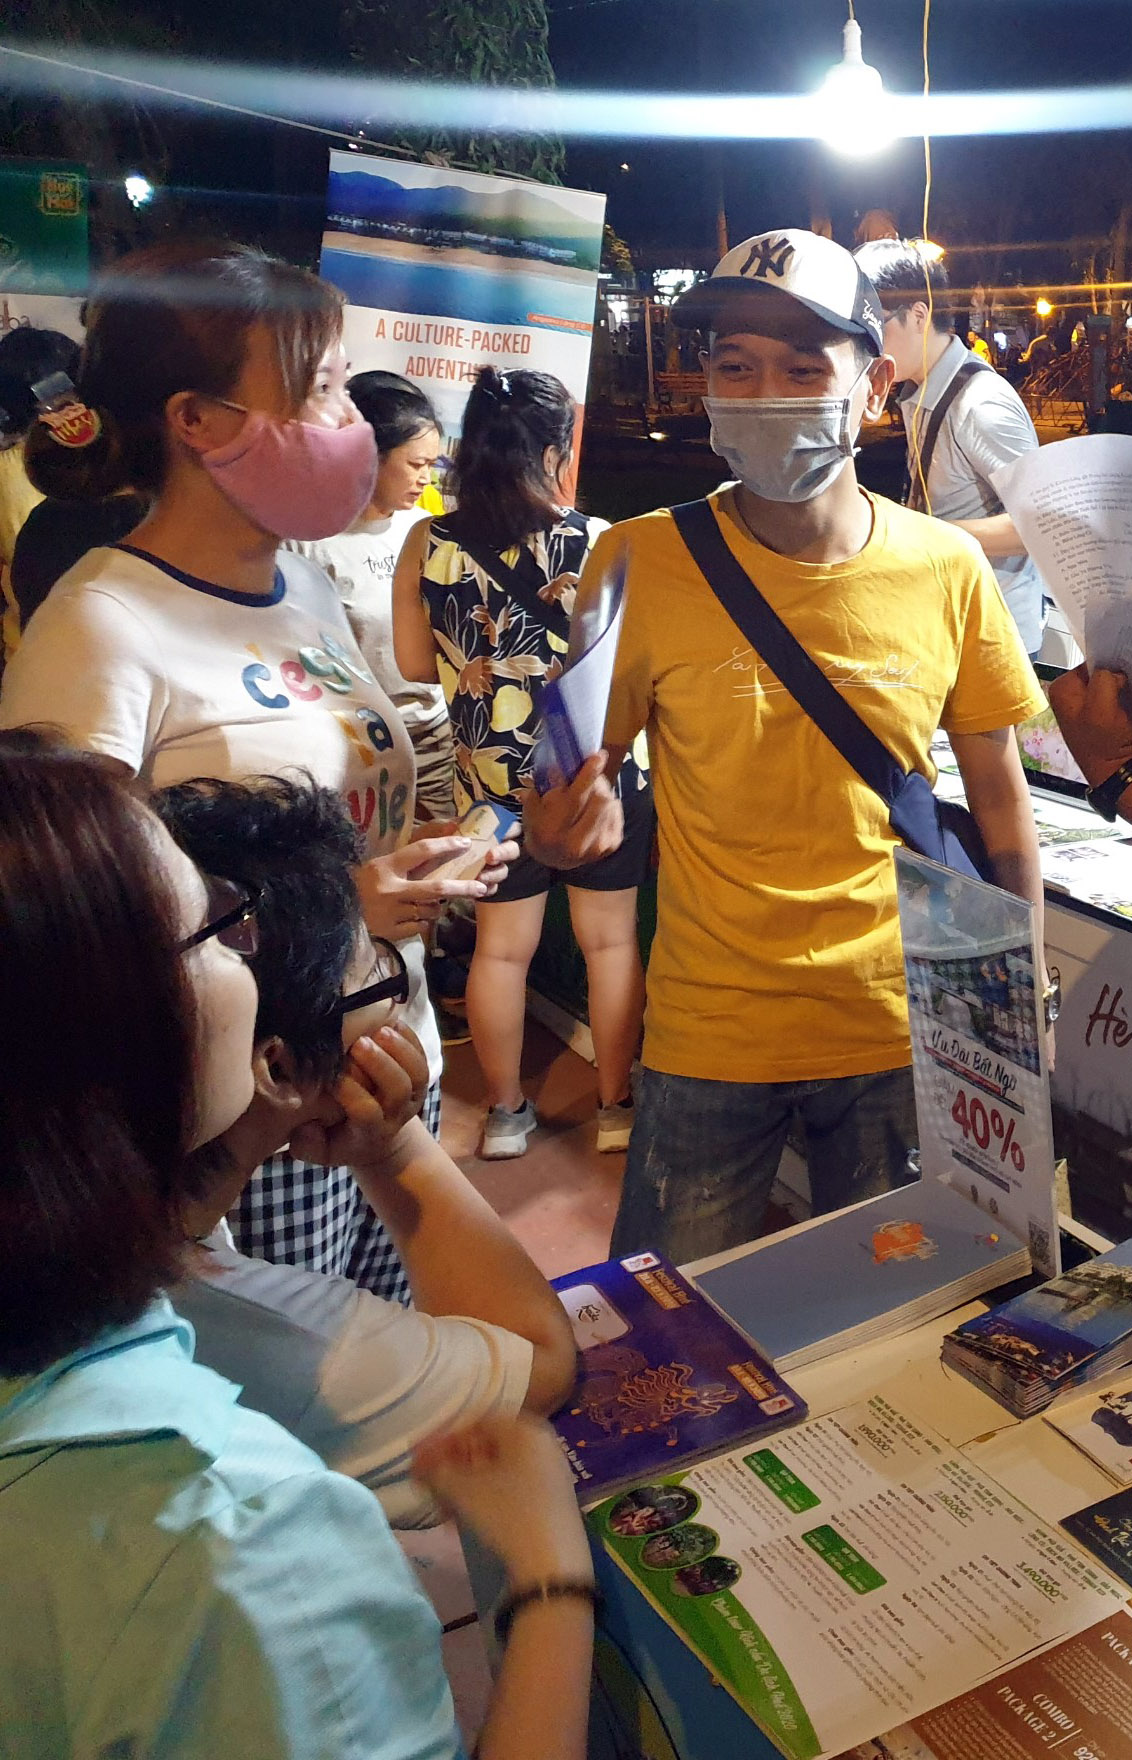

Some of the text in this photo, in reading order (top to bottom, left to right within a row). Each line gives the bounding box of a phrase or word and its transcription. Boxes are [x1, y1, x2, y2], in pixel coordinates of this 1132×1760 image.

[740, 237, 796, 278] NY
[375, 318, 387, 339] A
[393, 320, 532, 354] CULTURE-PACKED
[1085, 983, 1132, 1048] Hè
[951, 1088, 1025, 1173] 40%
[996, 1686, 1057, 1742] PACKAGE 2
[1032, 1693, 1075, 1730] COMBO
